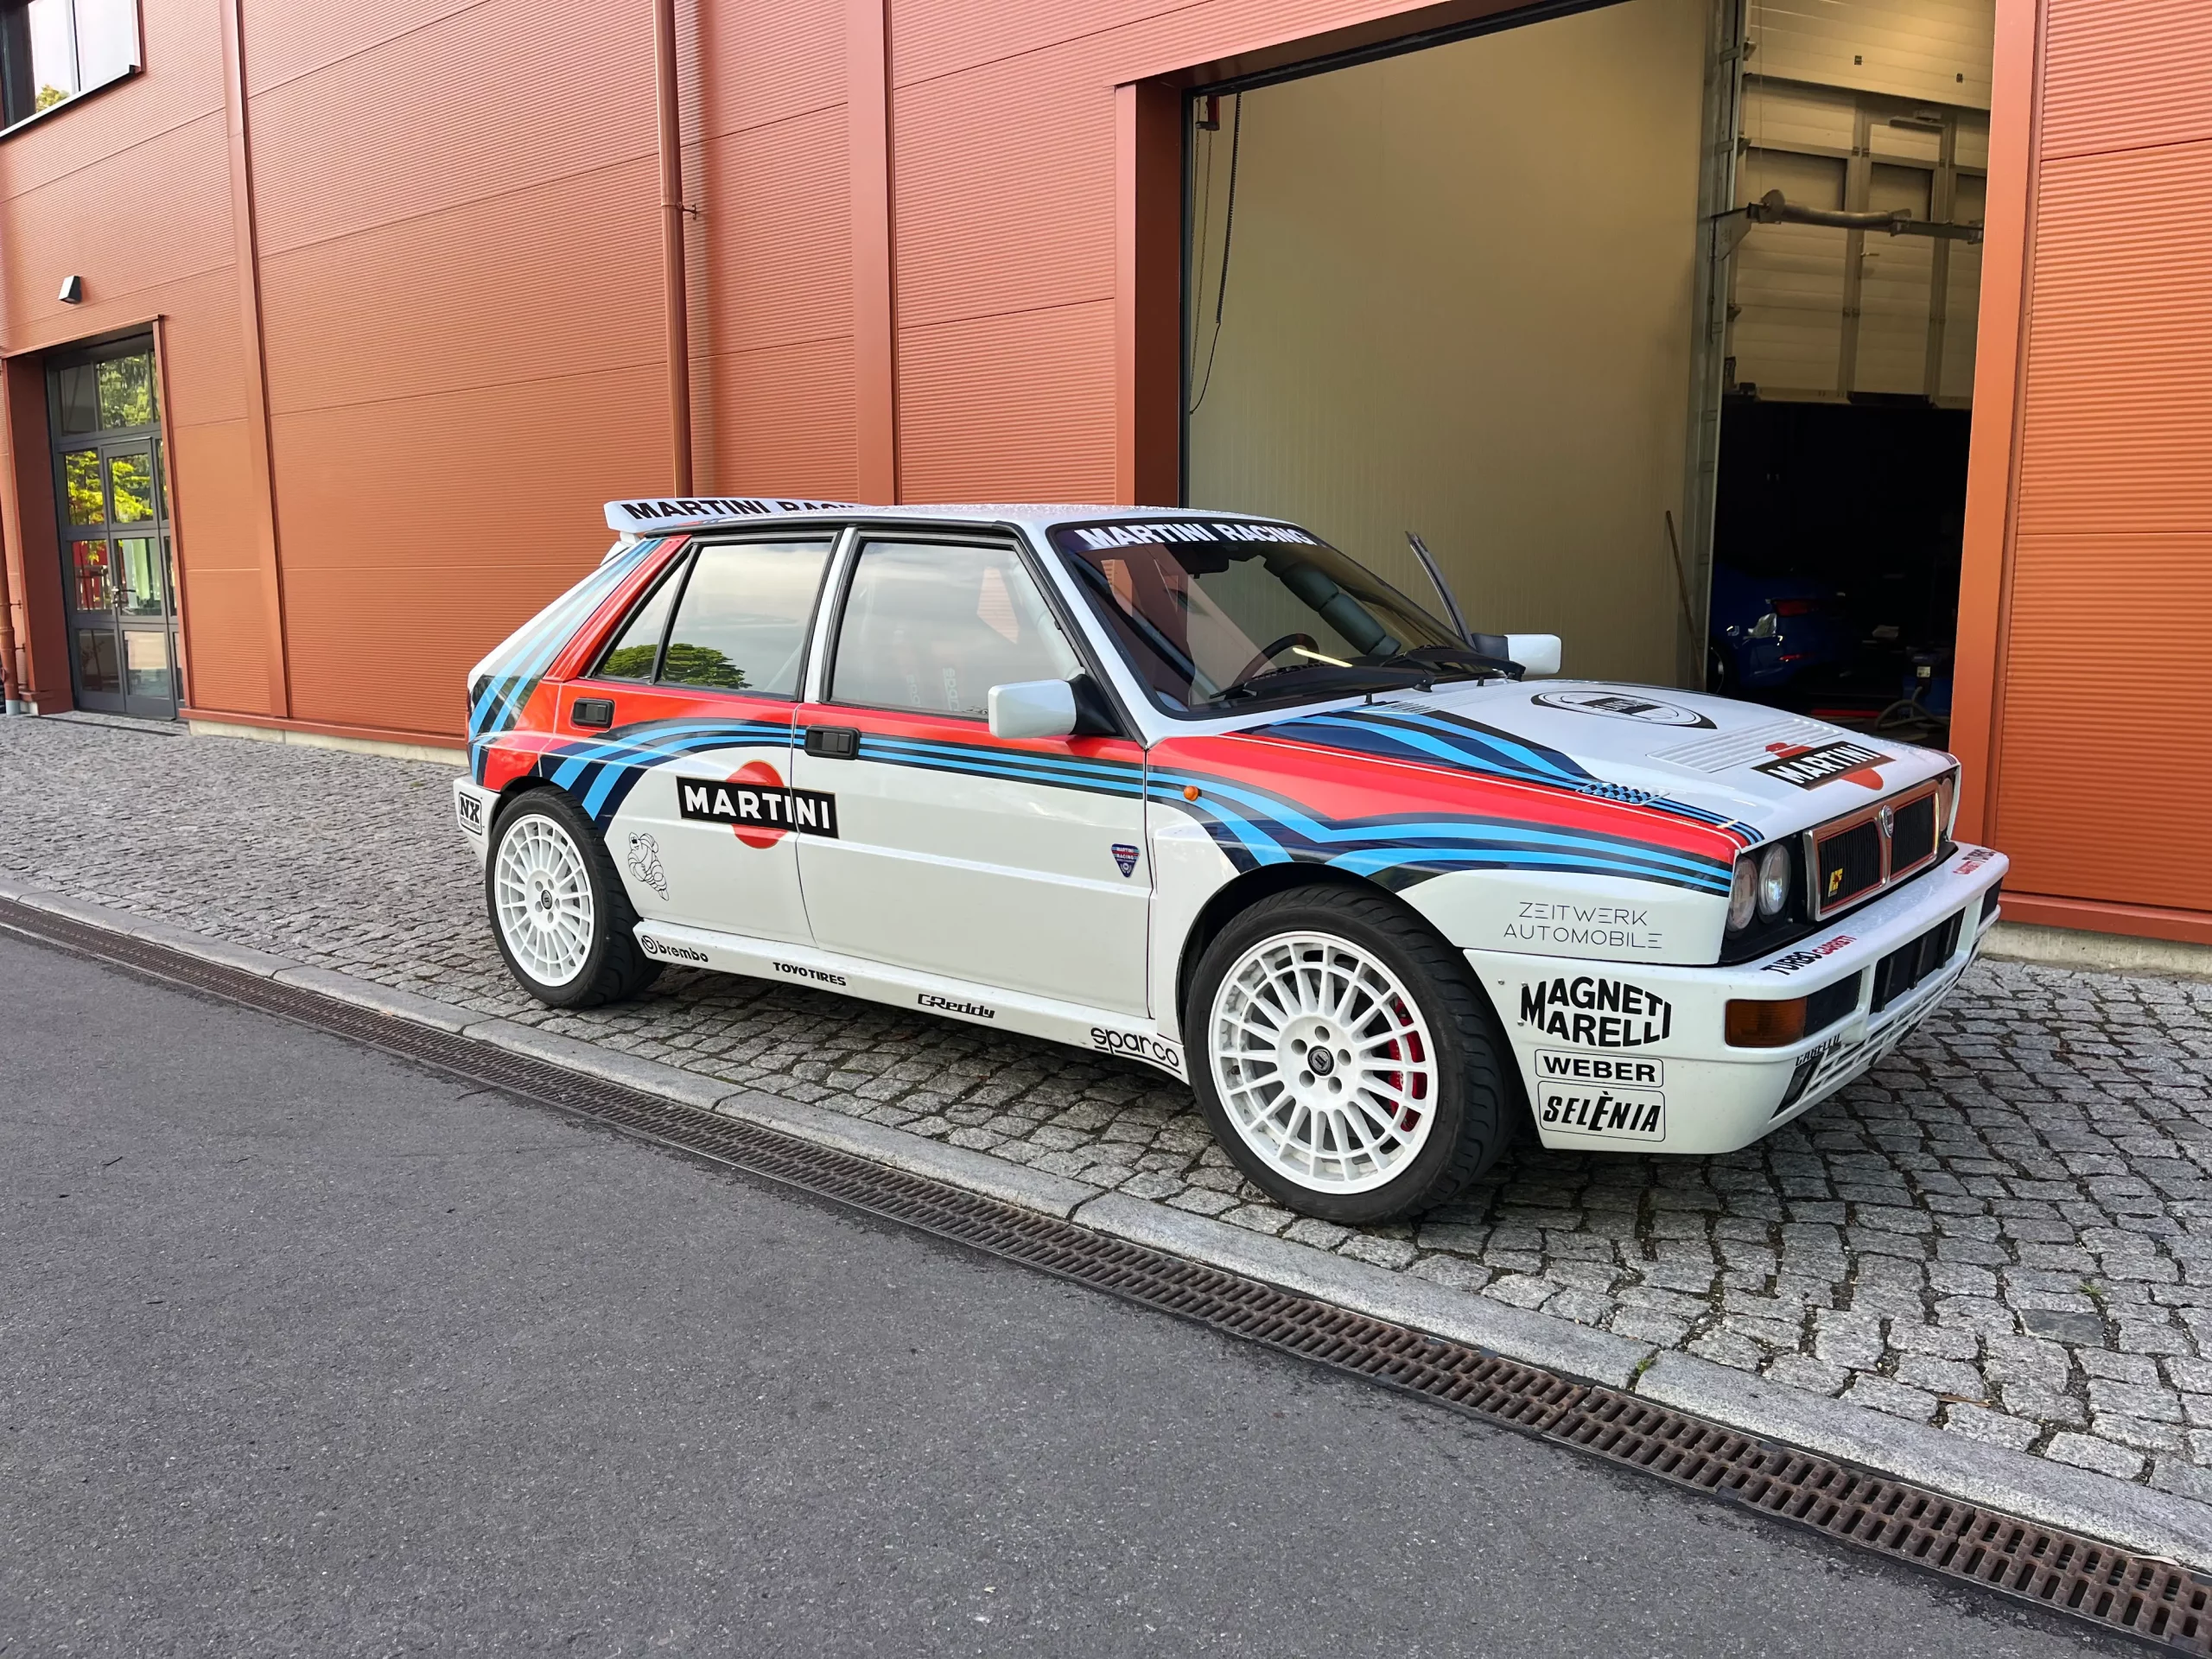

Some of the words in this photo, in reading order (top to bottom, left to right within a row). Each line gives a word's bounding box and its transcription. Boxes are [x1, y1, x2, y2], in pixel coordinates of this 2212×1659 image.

[621, 499, 772, 520] MARTINI
[1074, 524, 1218, 548] MARTINI
[1211, 524, 1317, 546] RACING
[1768, 744, 1880, 785] MARTINI
[460, 796, 480, 824] NX
[684, 785, 830, 830] MARTINI
[1518, 901, 1649, 926] ZEITWERK
[1503, 924, 1663, 950] AUTOMOBILE
[657, 940, 709, 963] brembo
[1759, 951, 1822, 976] TURBO
[1521, 976, 1672, 1033] MAGNETI
[1521, 985, 1672, 1047] MARELLI
[1090, 1027, 1180, 1068] sparco
[1543, 1056, 1656, 1083] WEBER
[1542, 1090, 1662, 1133] SELÈNIA
